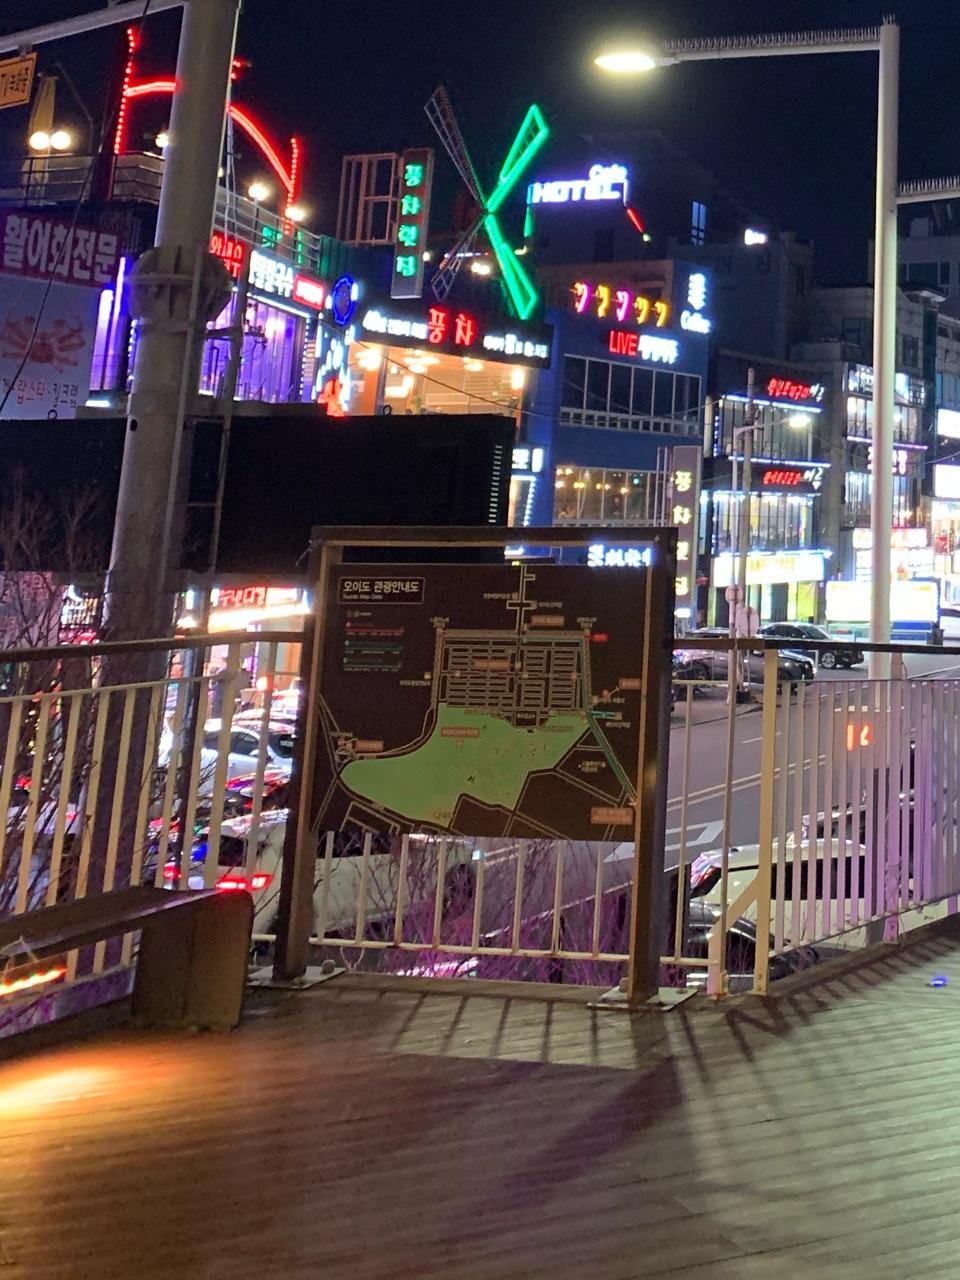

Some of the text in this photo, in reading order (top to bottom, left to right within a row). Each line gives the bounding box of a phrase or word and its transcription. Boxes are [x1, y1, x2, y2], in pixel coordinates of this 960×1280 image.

[532, 180, 621, 203] HOTEL
[4, 215, 118, 284] 활어회전문
[610, 330, 639, 357] LIVE
[343, 581, 419, 593] 오이도 관광안내도
